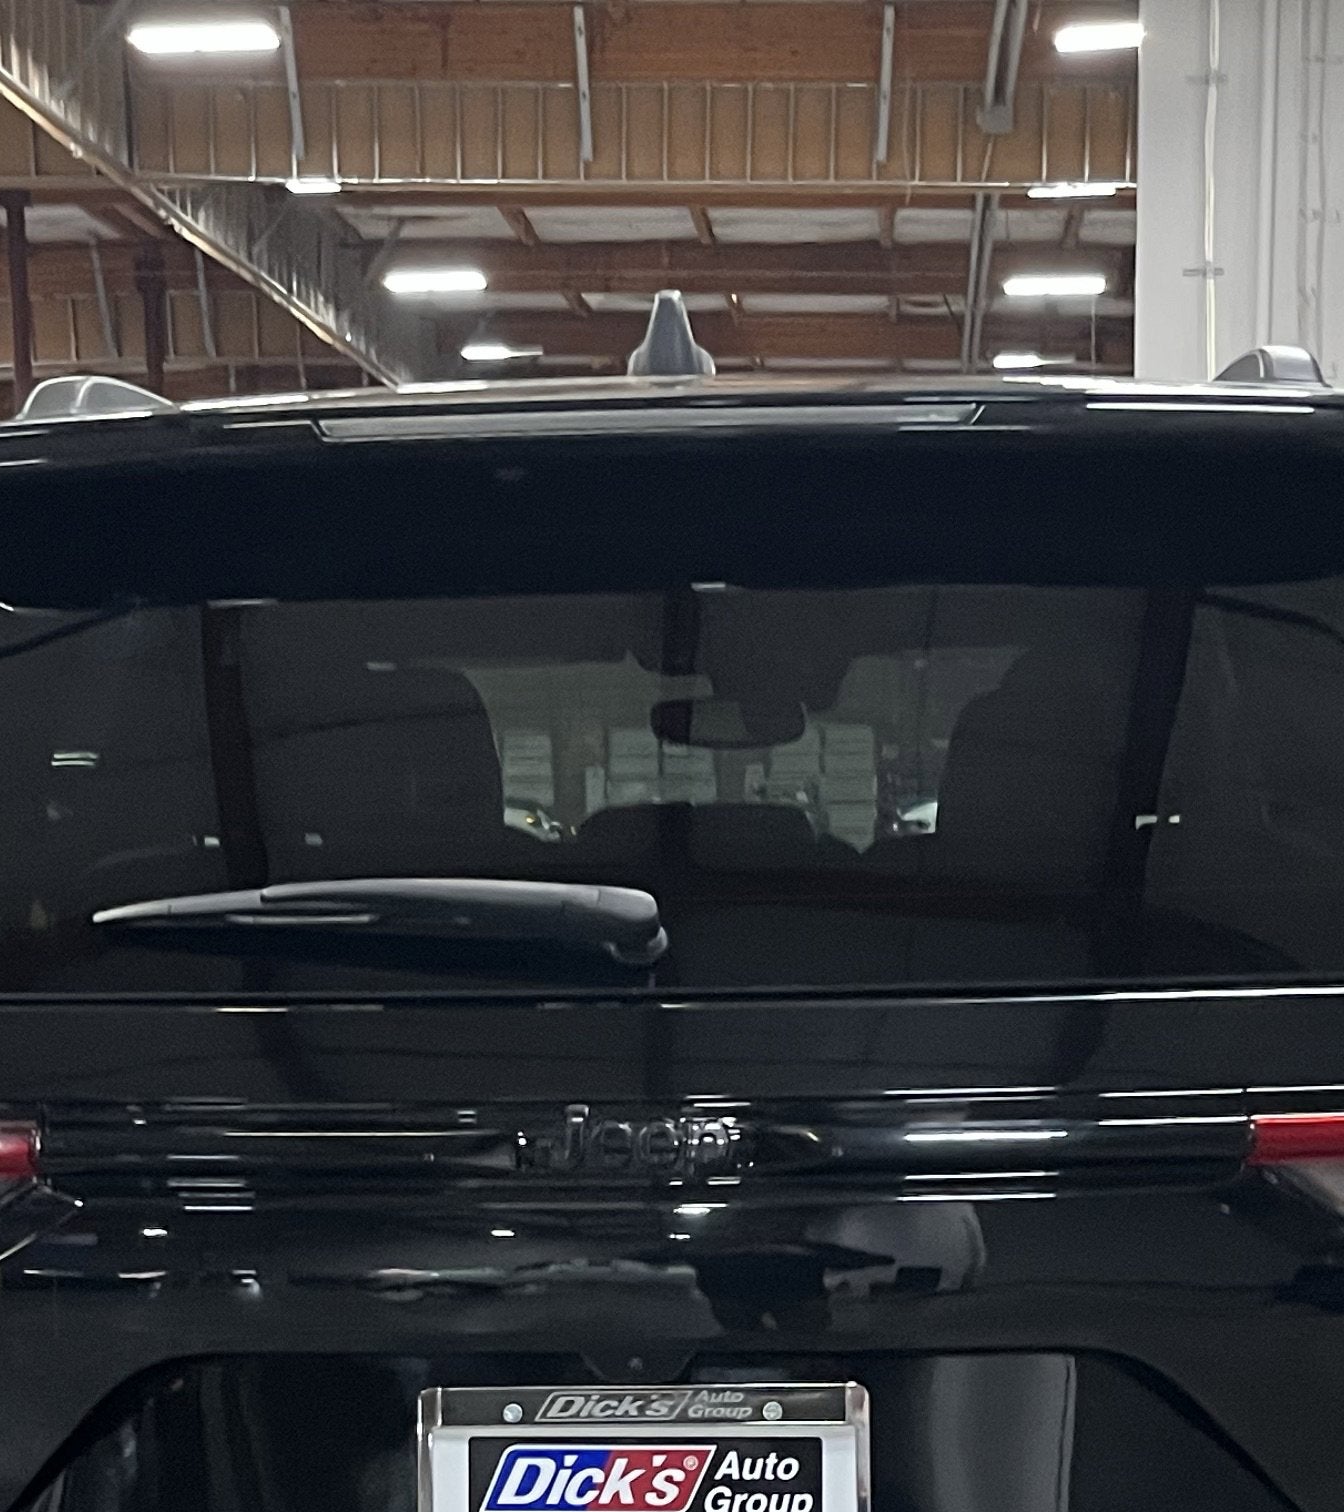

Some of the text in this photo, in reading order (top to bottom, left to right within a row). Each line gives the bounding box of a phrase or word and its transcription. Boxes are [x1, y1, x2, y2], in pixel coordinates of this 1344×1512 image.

[546, 1393, 675, 1418] Dick's
[695, 1390, 744, 1403] Auto
[688, 1405, 753, 1420] Group
[714, 1450, 800, 1481] Auto
[496, 1453, 687, 1506] Dick's
